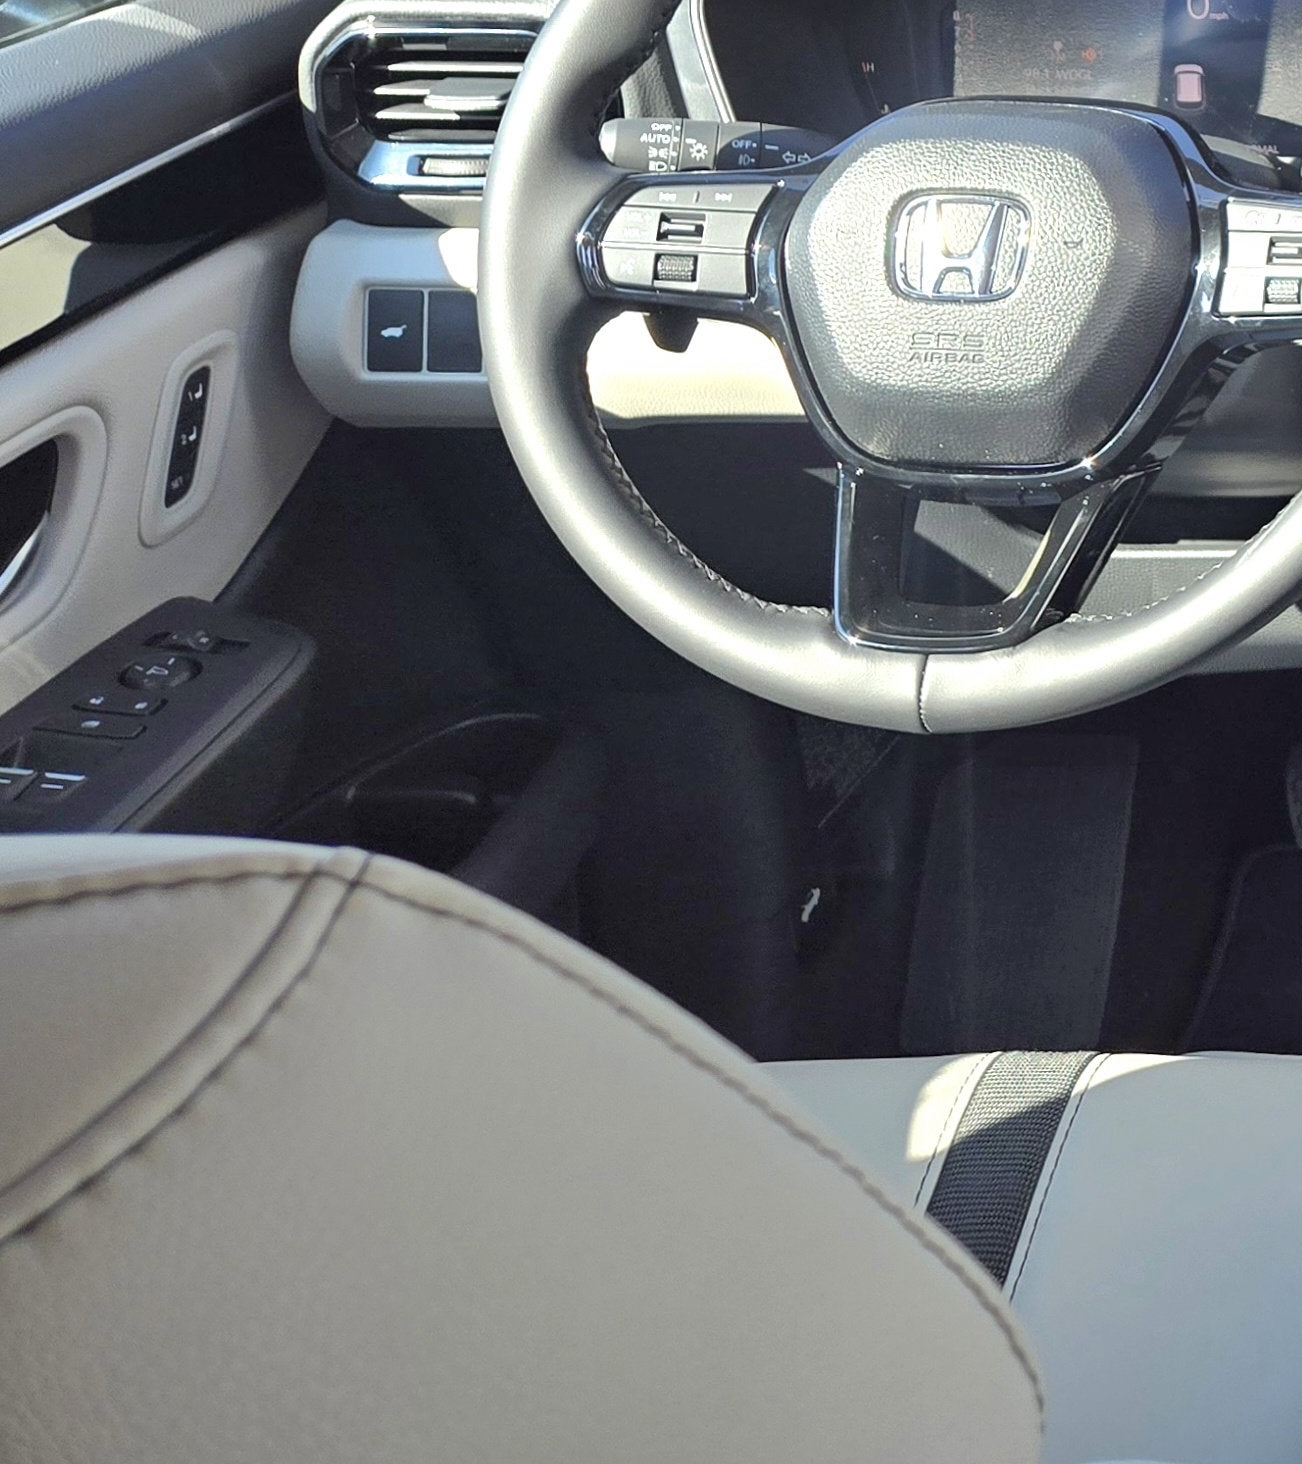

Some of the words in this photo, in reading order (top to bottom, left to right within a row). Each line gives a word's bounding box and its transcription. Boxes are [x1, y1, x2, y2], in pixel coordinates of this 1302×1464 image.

[1209, 12, 1230, 21] mph
[640, 133, 671, 144] AUTO
[731, 139, 751, 149] OFF
[911, 332, 984, 347] SRS
[908, 351, 985, 363] AIRBAG
